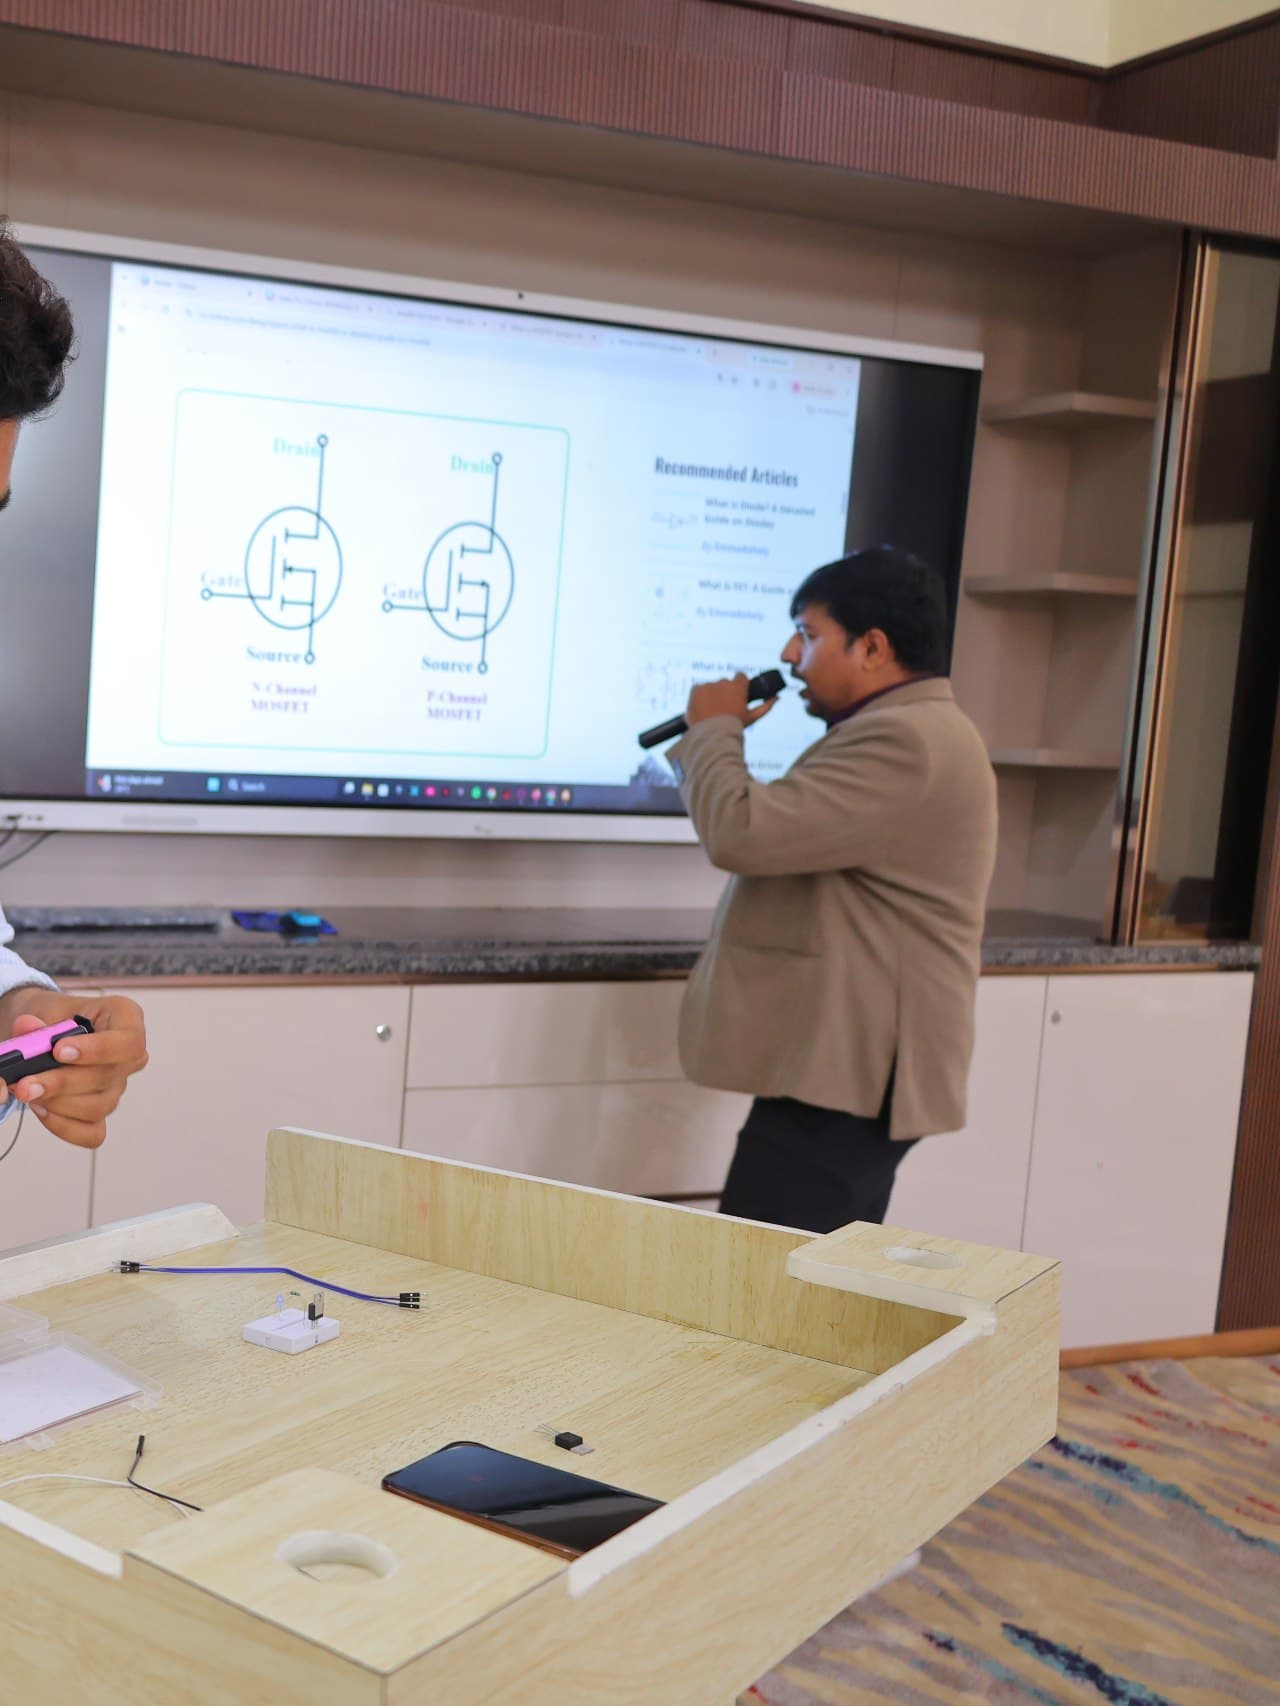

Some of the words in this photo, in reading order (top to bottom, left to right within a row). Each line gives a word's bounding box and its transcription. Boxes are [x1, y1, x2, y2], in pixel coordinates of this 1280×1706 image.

[450, 455, 494, 475] Drain
[655, 456, 748, 484] Recommended
[751, 467, 798, 488] Articles
[246, 646, 302, 663] Source
[422, 656, 474, 673] Source
[251, 698, 310, 714] MOSFET
[427, 707, 482, 722] MOSFET
